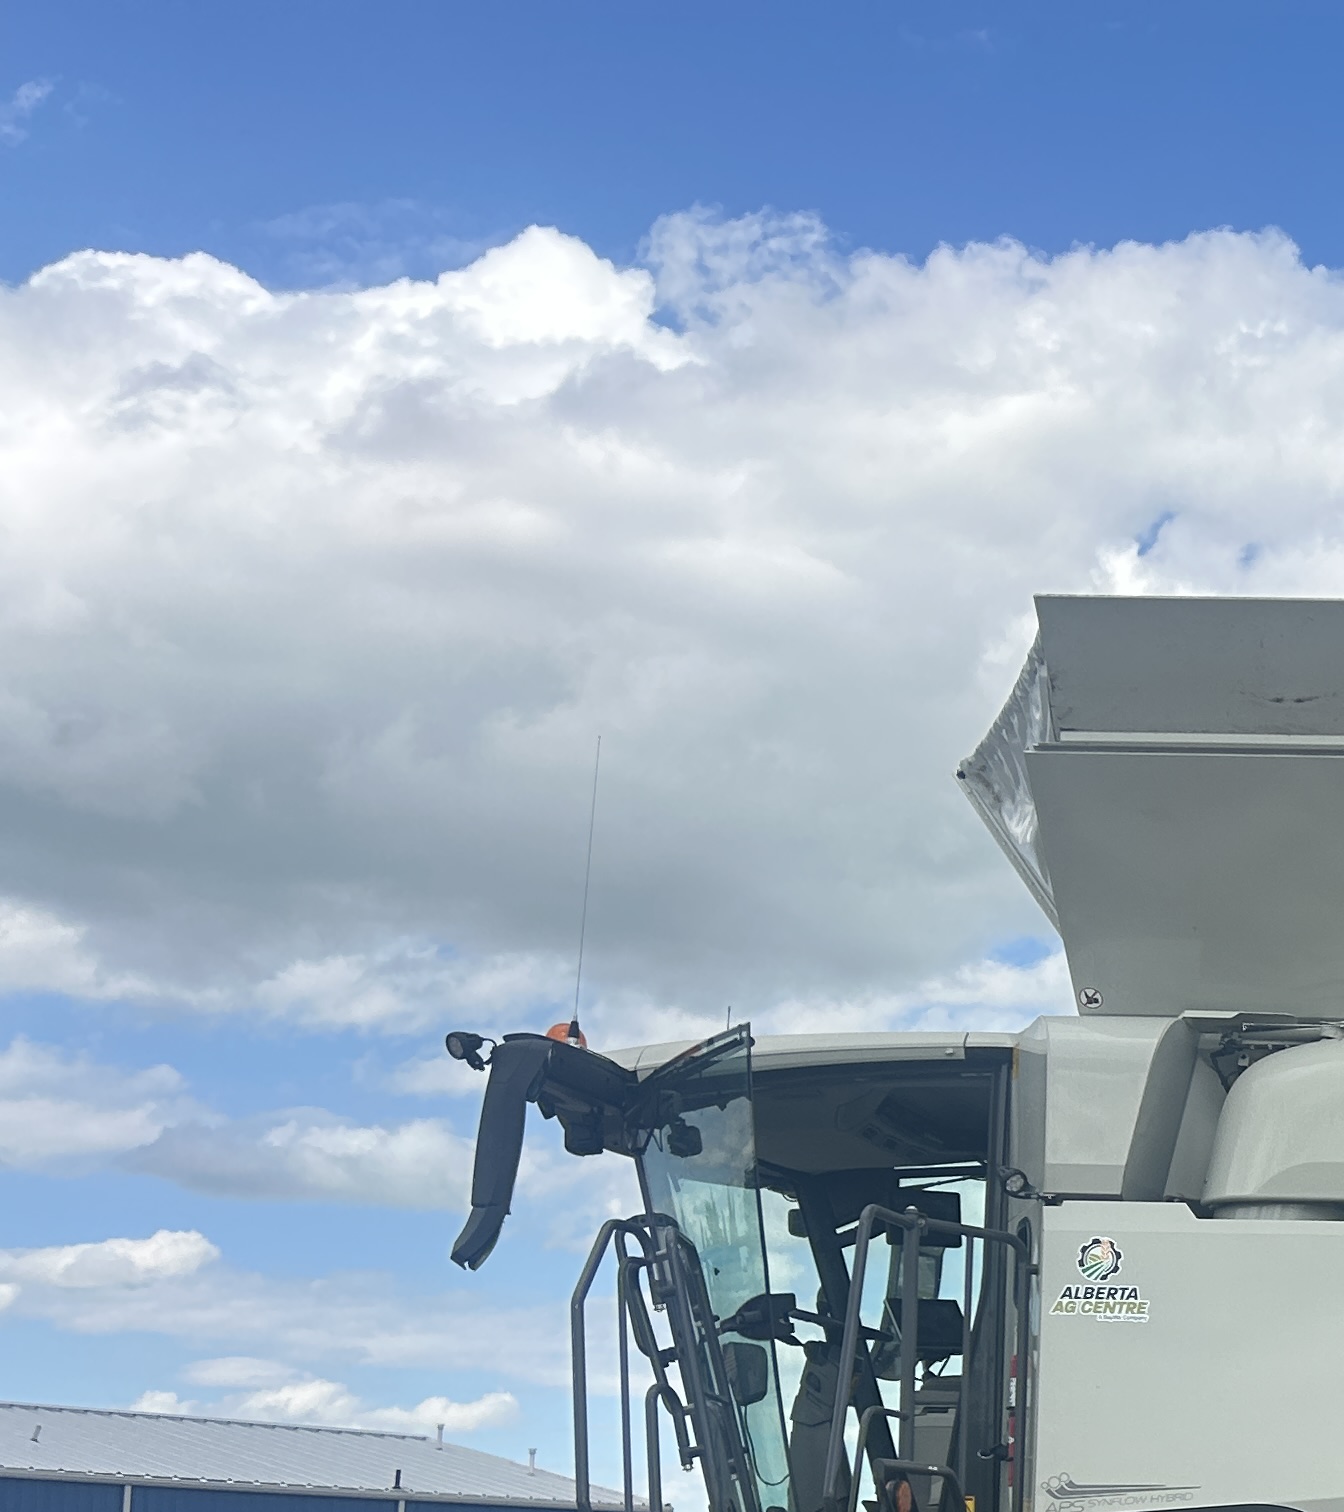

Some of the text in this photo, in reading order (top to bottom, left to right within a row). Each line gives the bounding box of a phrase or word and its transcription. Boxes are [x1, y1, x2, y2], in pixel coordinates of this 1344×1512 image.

[1060, 1286, 1139, 1301] ALBERTA
[1051, 1300, 1148, 1315] AG CENTRE
[1088, 1496, 1148, 1508] SYNFLOW
[1150, 1492, 1194, 1504] HYBRID
